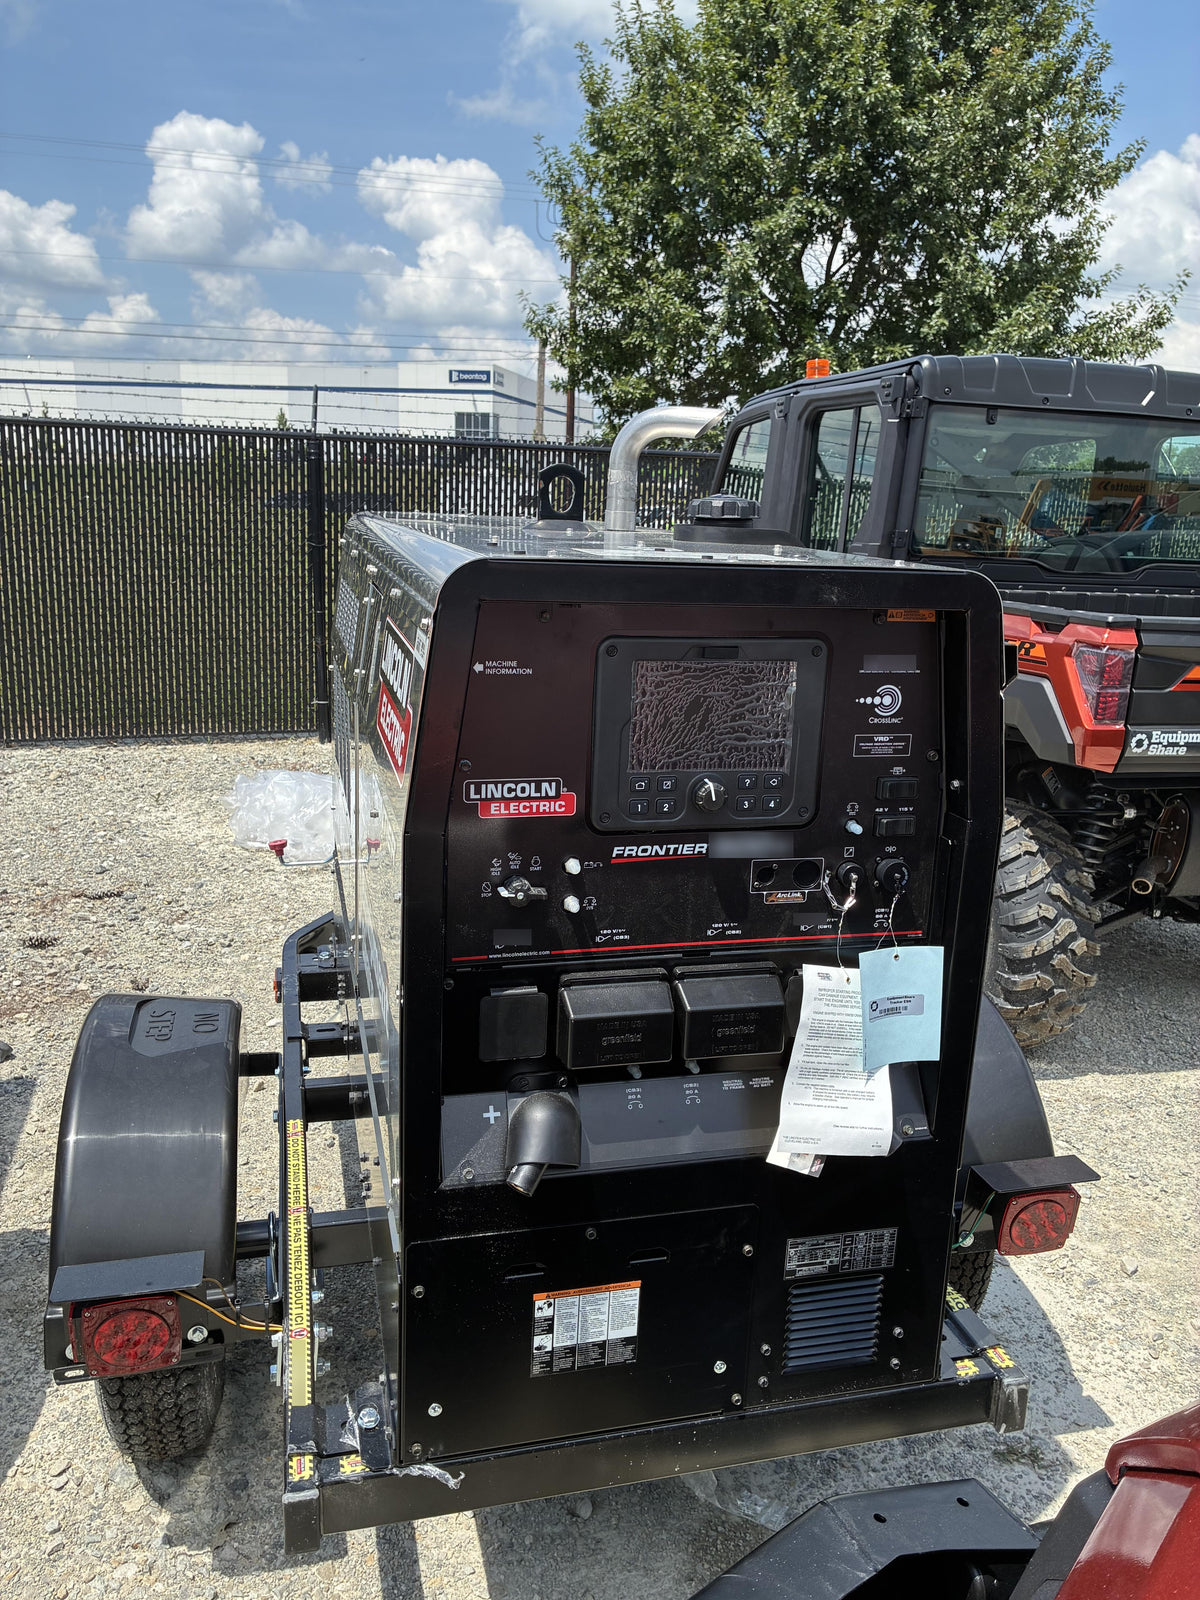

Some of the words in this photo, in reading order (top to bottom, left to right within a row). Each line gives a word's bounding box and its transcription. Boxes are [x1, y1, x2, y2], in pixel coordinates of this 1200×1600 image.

[460, 373, 487, 381] beontag
[381, 629, 411, 709] LINCOLN
[380, 693, 406, 767] ELECTRIC
[1147, 745, 1187, 755] Share
[469, 782, 556, 799] LINCOLN
[490, 801, 566, 815] ELECTRIC
[637, 804, 642, 812] 1
[769, 800, 775, 808] 4
[612, 843, 708, 858] FRONTIER
[488, 950, 551, 959] www.lincolnelectric.com
[145, 1009, 177, 1042] STEP
[192, 1012, 220, 1034] NO
[716, 1024, 756, 1037] greenfield
[601, 1032, 642, 1046] greenfield
[291, 1138, 299, 1147] DO
[291, 1148, 300, 1161] NOT
[292, 1163, 300, 1183] STAND
[292, 1184, 301, 1206] HERE
[293, 1215, 301, 1227] NE
[293, 1228, 301, 1244] PAS
[293, 1244, 302, 1272] TENEZ
[294, 1274, 303, 1311] DEBOUT
[294, 1313, 304, 1326] ICI
